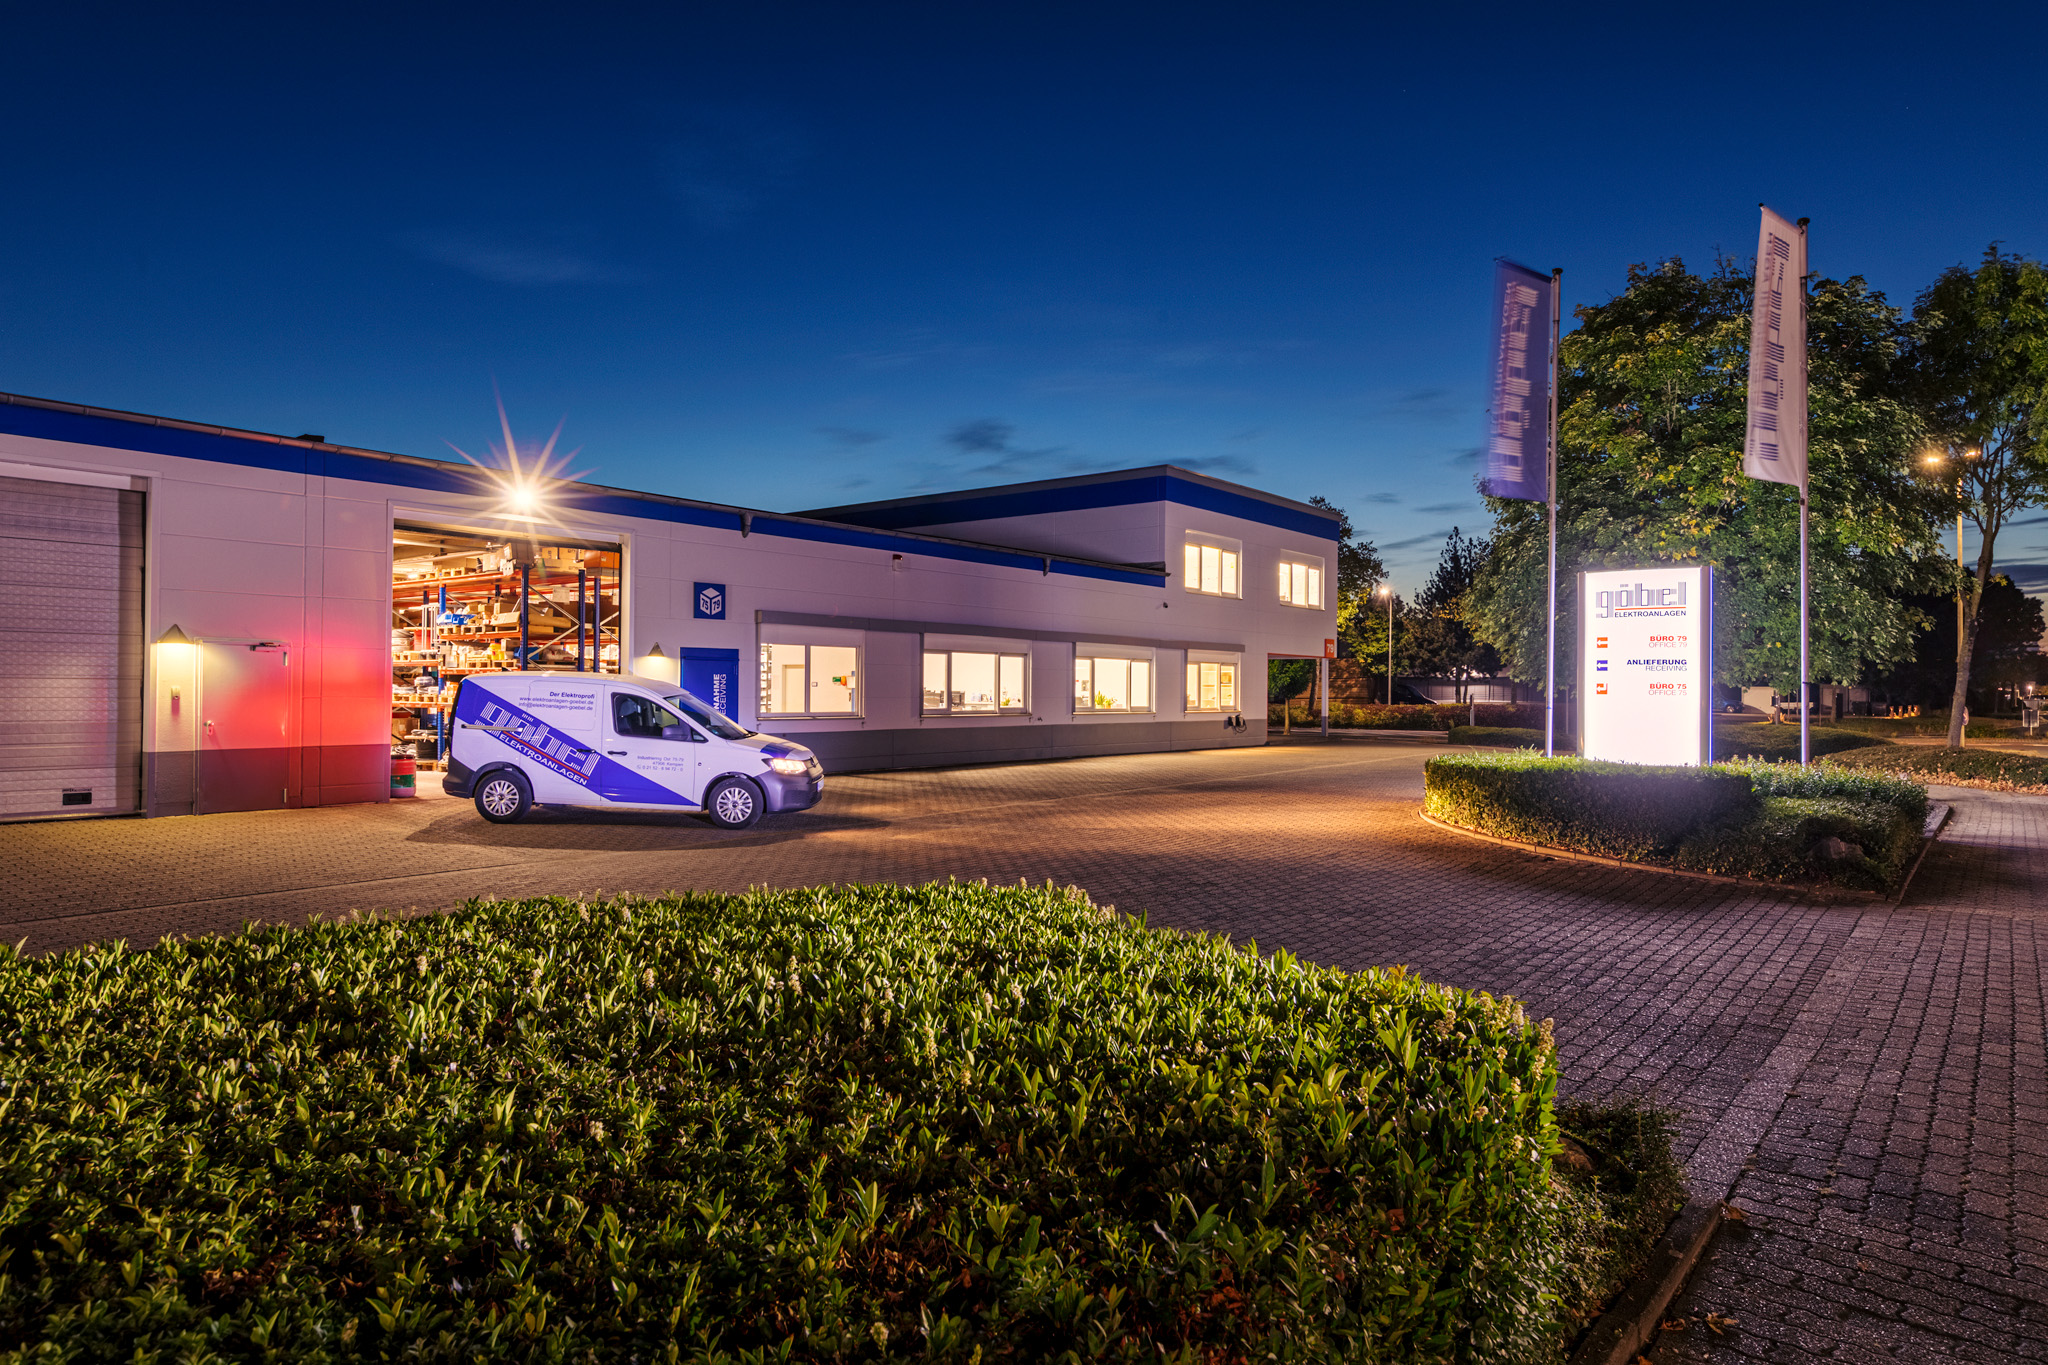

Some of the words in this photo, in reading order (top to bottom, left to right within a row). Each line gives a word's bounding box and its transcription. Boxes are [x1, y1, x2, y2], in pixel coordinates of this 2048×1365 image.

[701, 598, 709, 610] 75
[713, 599, 720, 611] 79
[1596, 582, 1686, 618] göbel
[1615, 610, 1686, 618] ELEKTROANLAGEN
[1327, 643, 1334, 653] 79
[519, 697, 594, 705] www.elektroanlagen-goebel.de
[519, 702, 593, 710] info@elektroanlagen-goebel.de
[474, 701, 600, 776] göbel
[499, 733, 588, 785] ELEKTROANLAGEN
